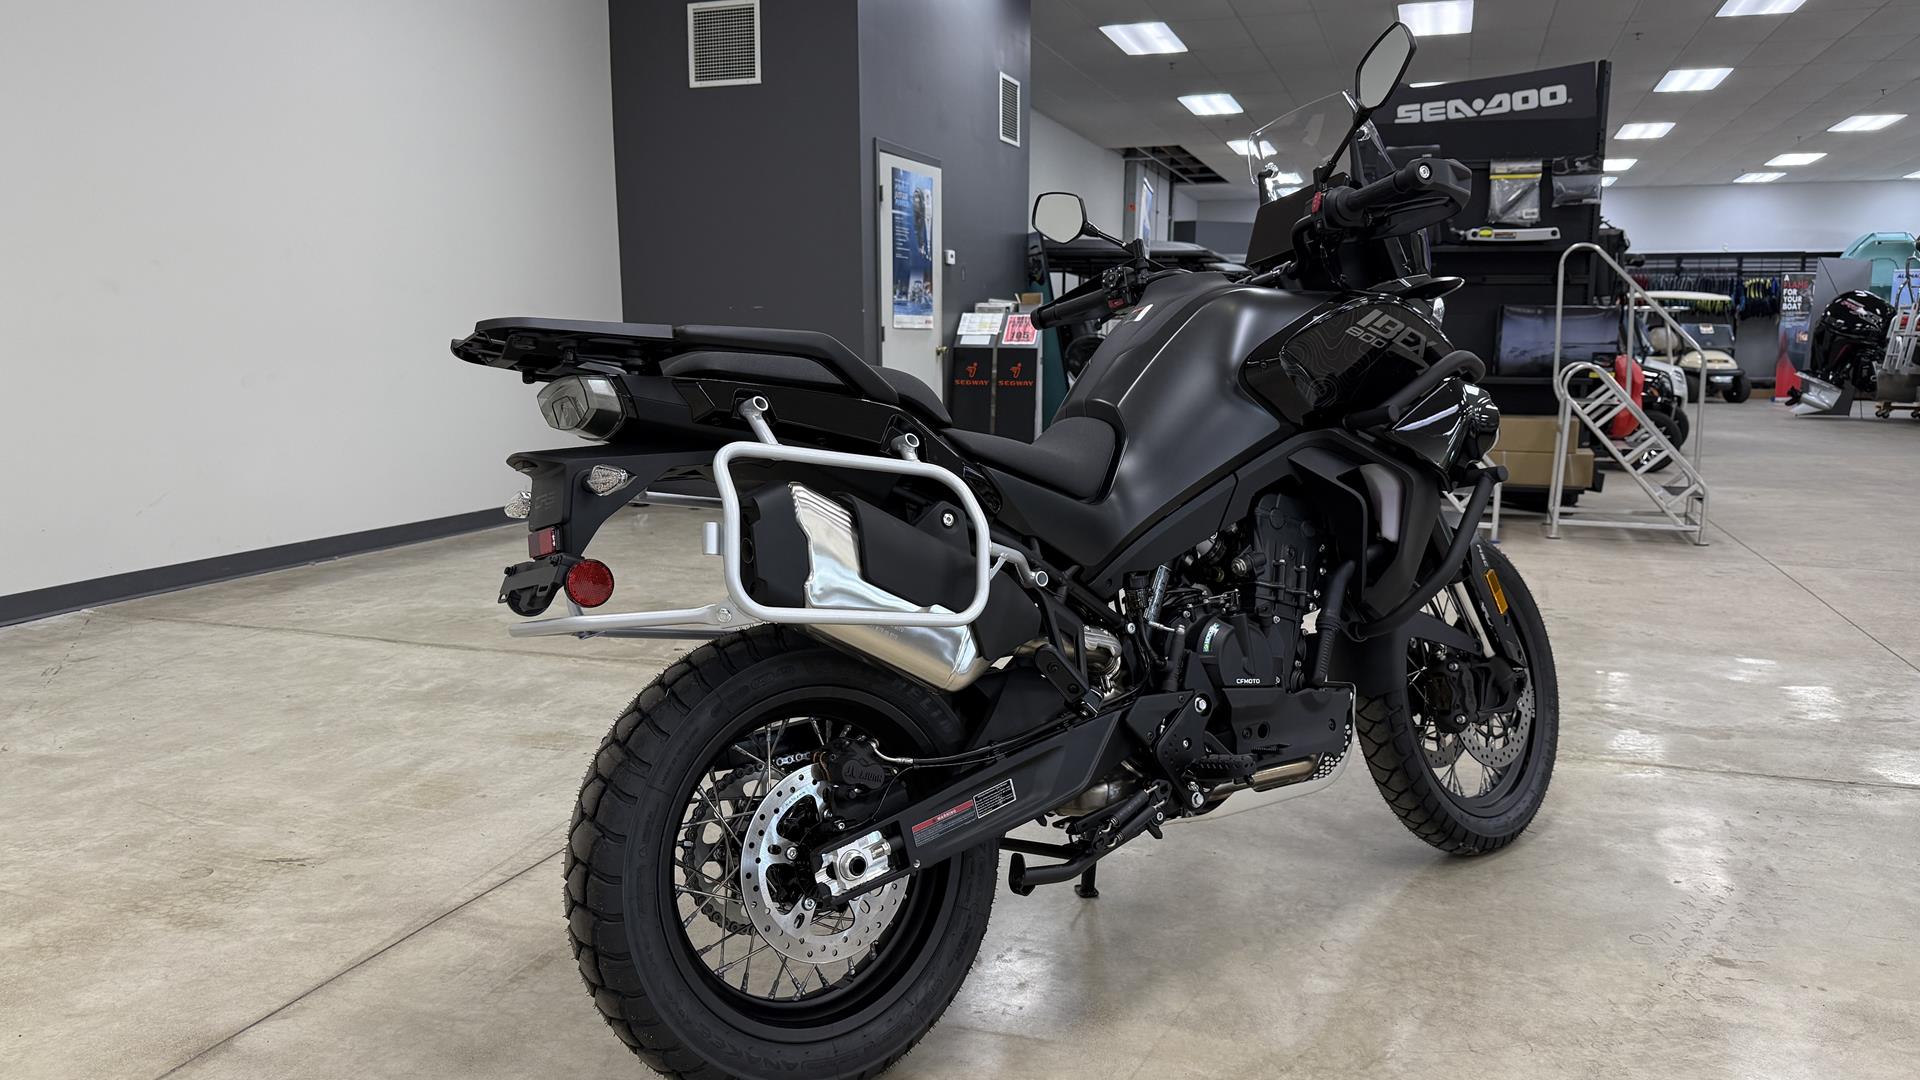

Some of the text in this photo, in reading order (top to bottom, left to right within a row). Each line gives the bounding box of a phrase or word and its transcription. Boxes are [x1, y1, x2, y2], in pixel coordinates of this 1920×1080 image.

[1782, 302, 1801, 310] BOAT
[1783, 295, 1802, 303] YOUR
[1345, 327, 1388, 349] 800
[1356, 308, 1438, 357] IBEX
